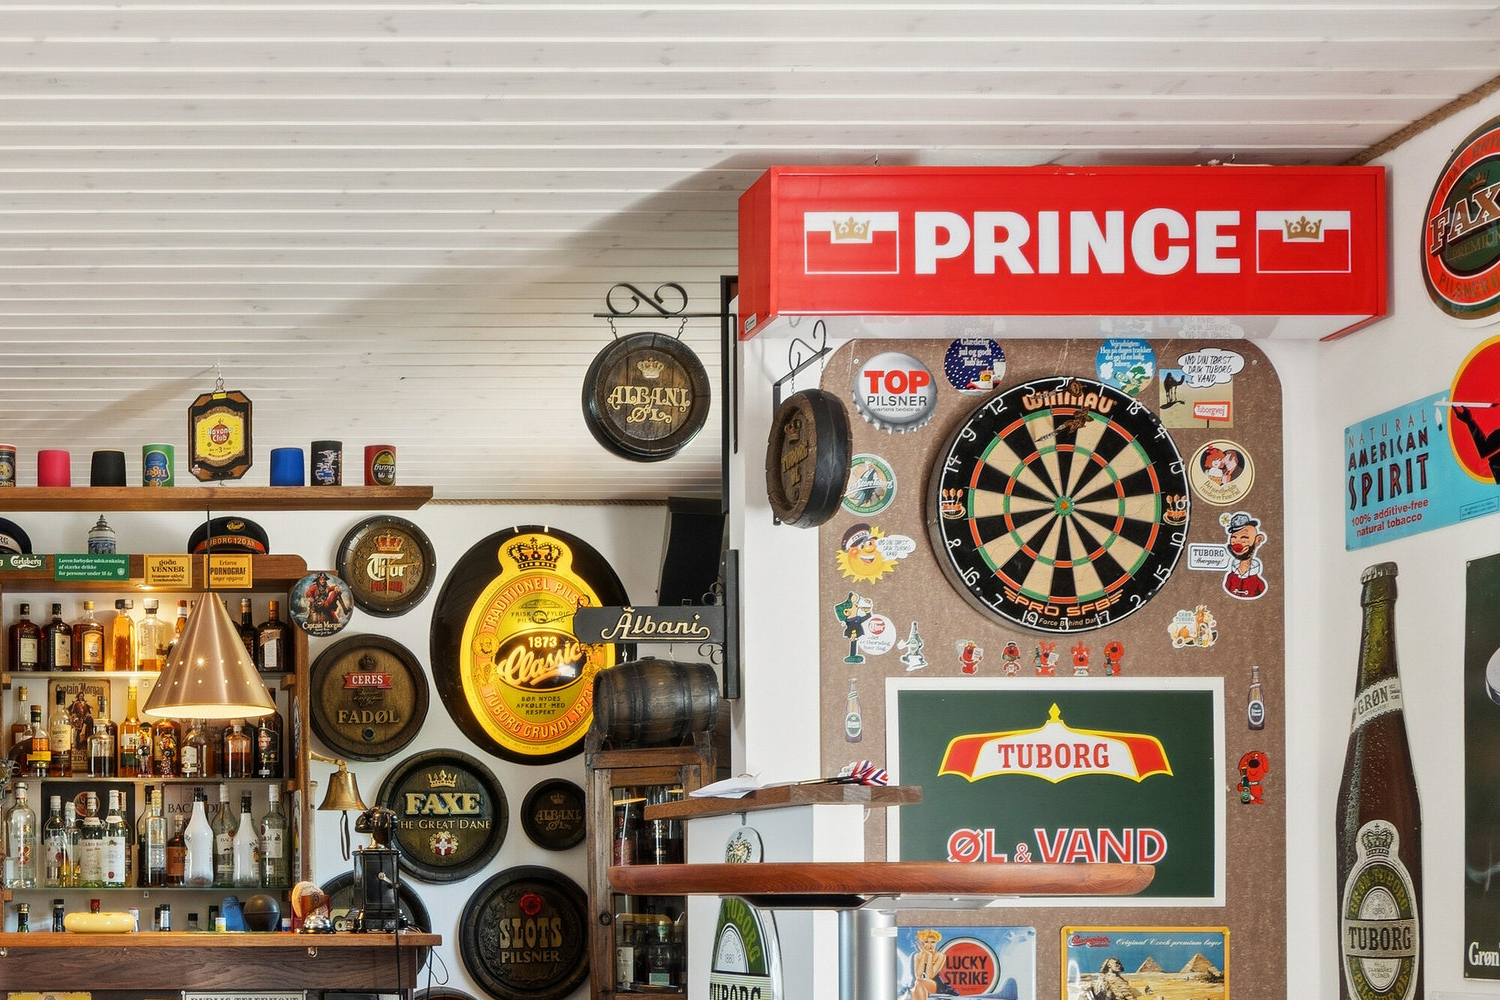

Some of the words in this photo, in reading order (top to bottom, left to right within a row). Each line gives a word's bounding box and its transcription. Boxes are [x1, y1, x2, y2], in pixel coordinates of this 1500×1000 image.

[1430, 181, 1500, 255] FAX
[914, 207, 1242, 277] PRINCE
[1197, 374, 1217, 384] VAND
[1205, 364, 1233, 374] TUBORG
[863, 370, 930, 395] TOP
[606, 384, 691, 413] ALBANI
[867, 395, 928, 407] PILSNER
[986, 398, 1009, 416] 12
[625, 405, 673, 425] ØL
[212, 433, 228, 443] Club
[1348, 407, 1428, 449] NATURAL
[1347, 425, 1430, 472] AMERICAN
[1348, 453, 1431, 512] SPIRIT
[1350, 511, 1373, 528] 100%
[1373, 498, 1430, 523] additive-free
[1356, 519, 1394, 538] natural
[1394, 511, 1423, 531] tobacco
[10, 554, 43, 569] Carlsberg
[1193, 549, 1225, 558] TUBORG
[367, 553, 409, 579] Thor
[481, 576, 552, 635] TRADITIONEL
[1013, 596, 1060, 617] PRO
[600, 606, 711, 642] Albani
[527, 636, 558, 649] 1873
[496, 640, 584, 687] Classic
[352, 674, 384, 686] CERES
[538, 695, 561, 703] NYDES
[1356, 687, 1389, 717] GRØN
[337, 708, 400, 725] FADØL
[483, 686, 524, 737] TUBORG
[524, 709, 557, 717] RESPEKT
[998, 742, 1111, 769] TUBORG
[404, 792, 481, 816] FAXE
[417, 818, 456, 830] GREAT
[458, 818, 491, 830] DANE
[946, 827, 1008, 863] ØL
[1013, 842, 1033, 863] &
[1034, 827, 1168, 864] VAND
[500, 917, 563, 950] SLOTS
[1115, 938, 1148, 948] Original
[1149, 938, 1171, 946] Czech
[1170, 939, 1203, 948] premium
[1203, 938, 1223, 948] lager
[1348, 925, 1412, 951] TUBORG
[501, 951, 562, 965] PILSNER
[945, 955, 987, 971] LUCKY
[943, 971, 989, 986] STRIKE
